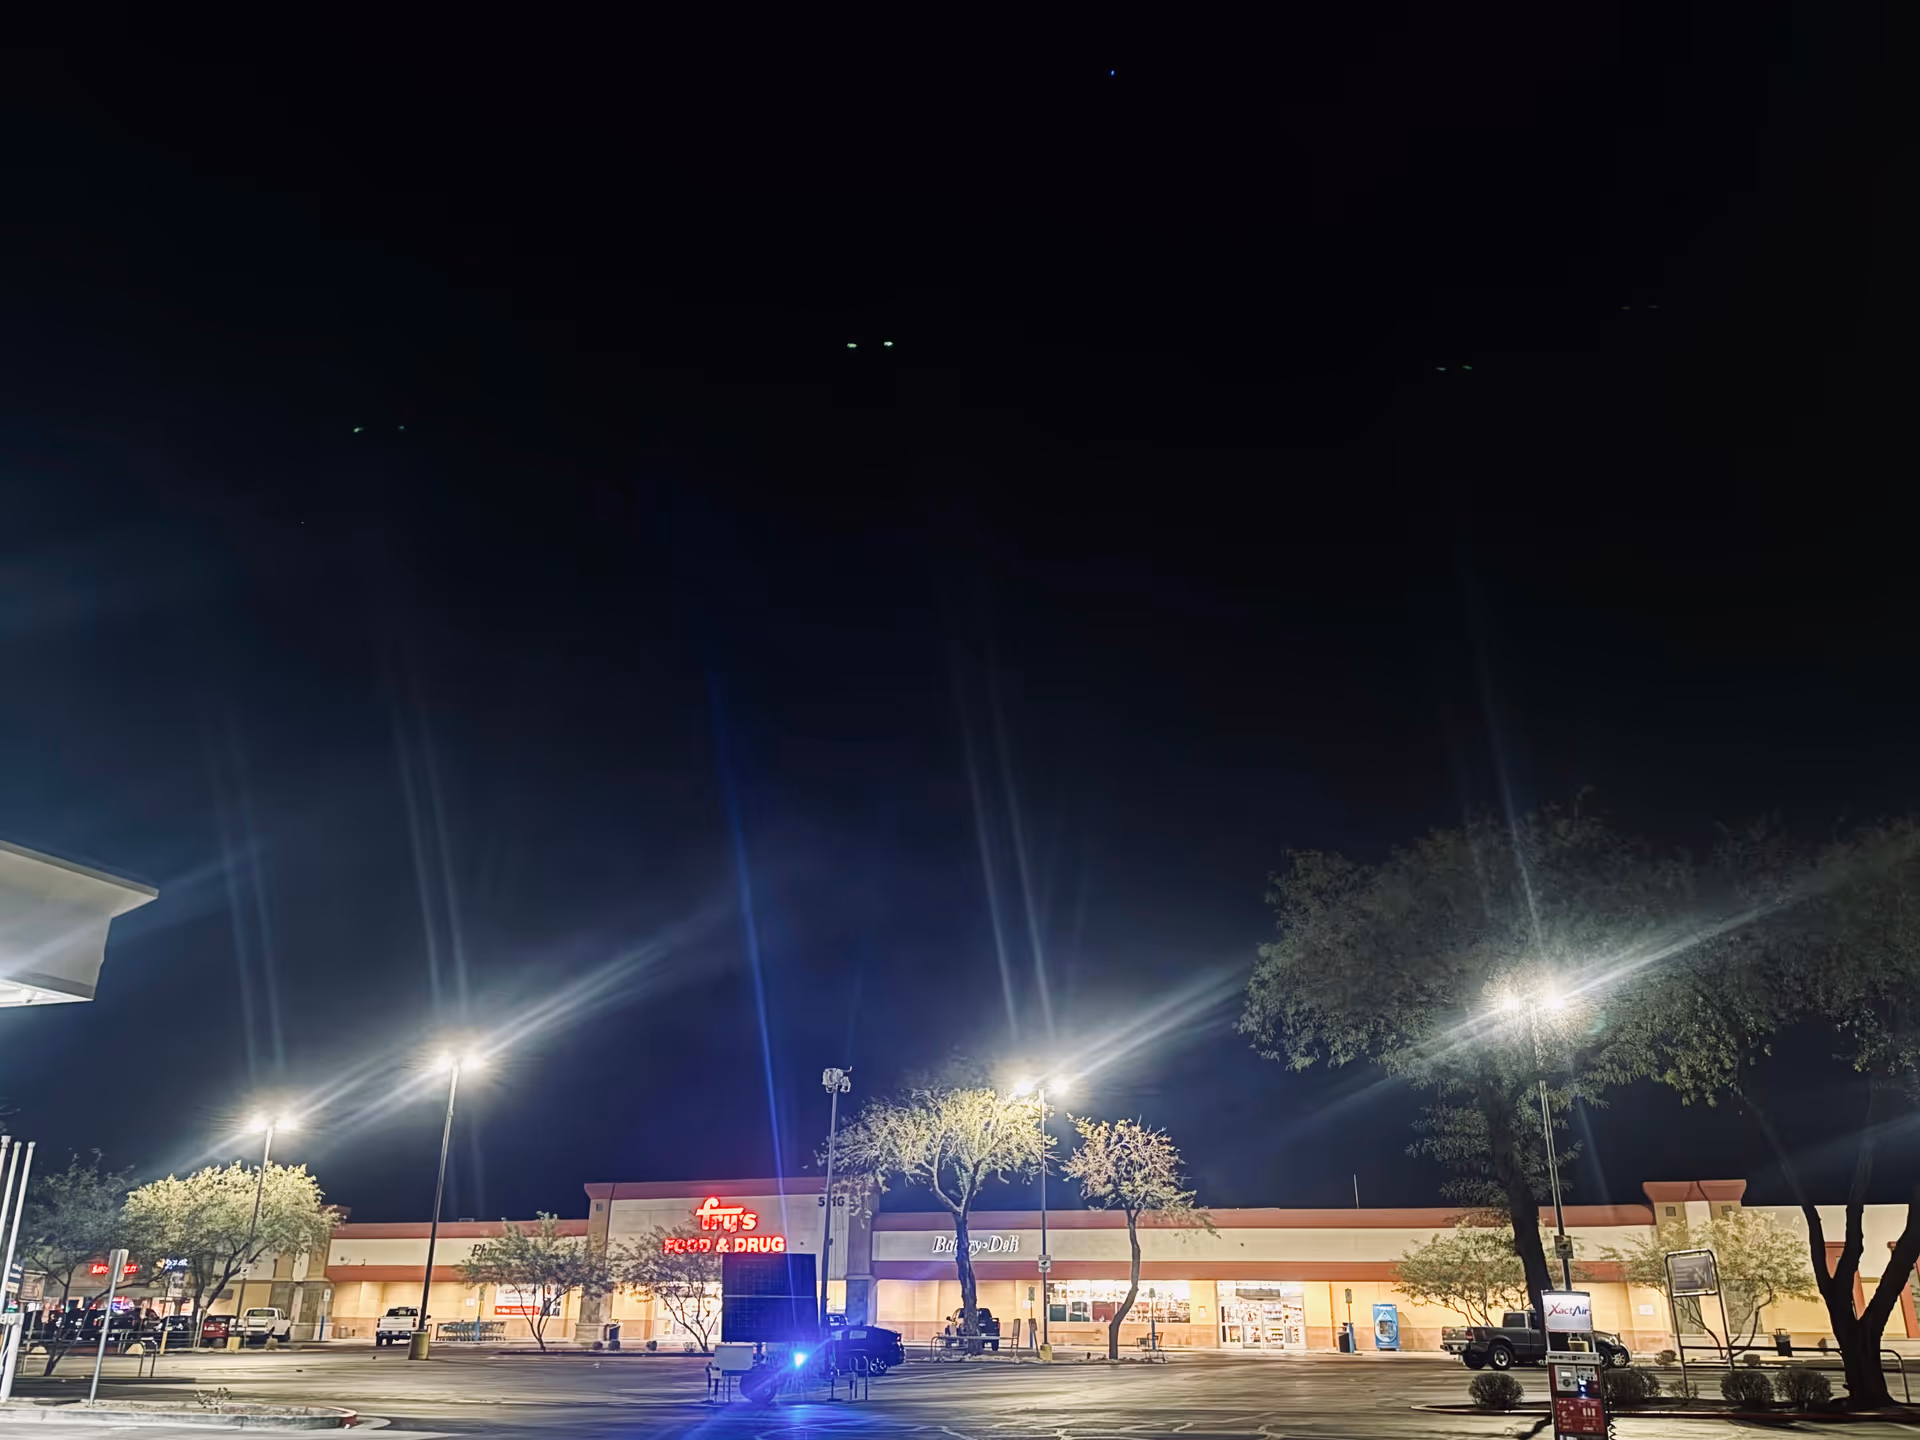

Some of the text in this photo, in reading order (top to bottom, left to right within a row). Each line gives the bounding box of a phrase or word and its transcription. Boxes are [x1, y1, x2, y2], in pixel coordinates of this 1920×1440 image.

[817, 1196, 845, 1207] 516
[663, 1236, 785, 1254] FOOD & DRUG
[1548, 1302, 1590, 1317] XactAir
